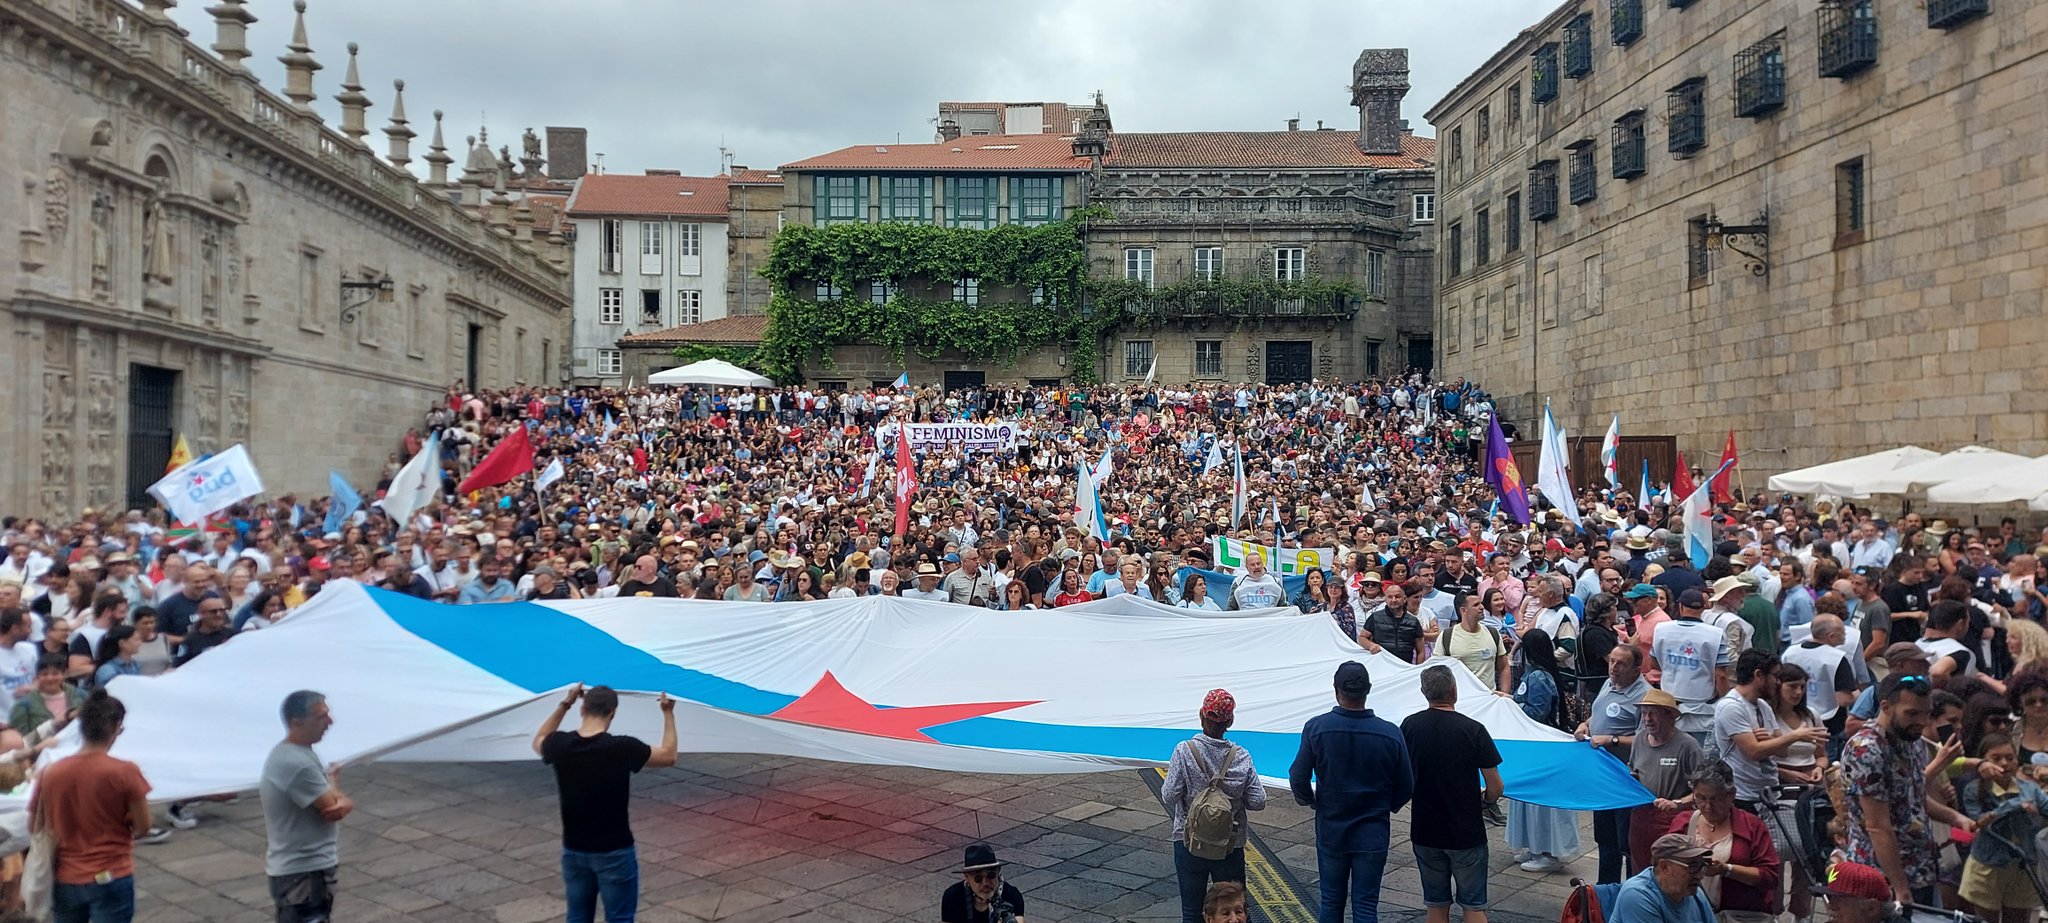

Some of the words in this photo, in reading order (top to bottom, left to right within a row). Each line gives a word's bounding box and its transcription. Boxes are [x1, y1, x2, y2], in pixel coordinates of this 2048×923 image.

[1219, 536, 1320, 575] LULA
[1246, 593, 1271, 608] bng
[1667, 648, 1700, 671] bng
